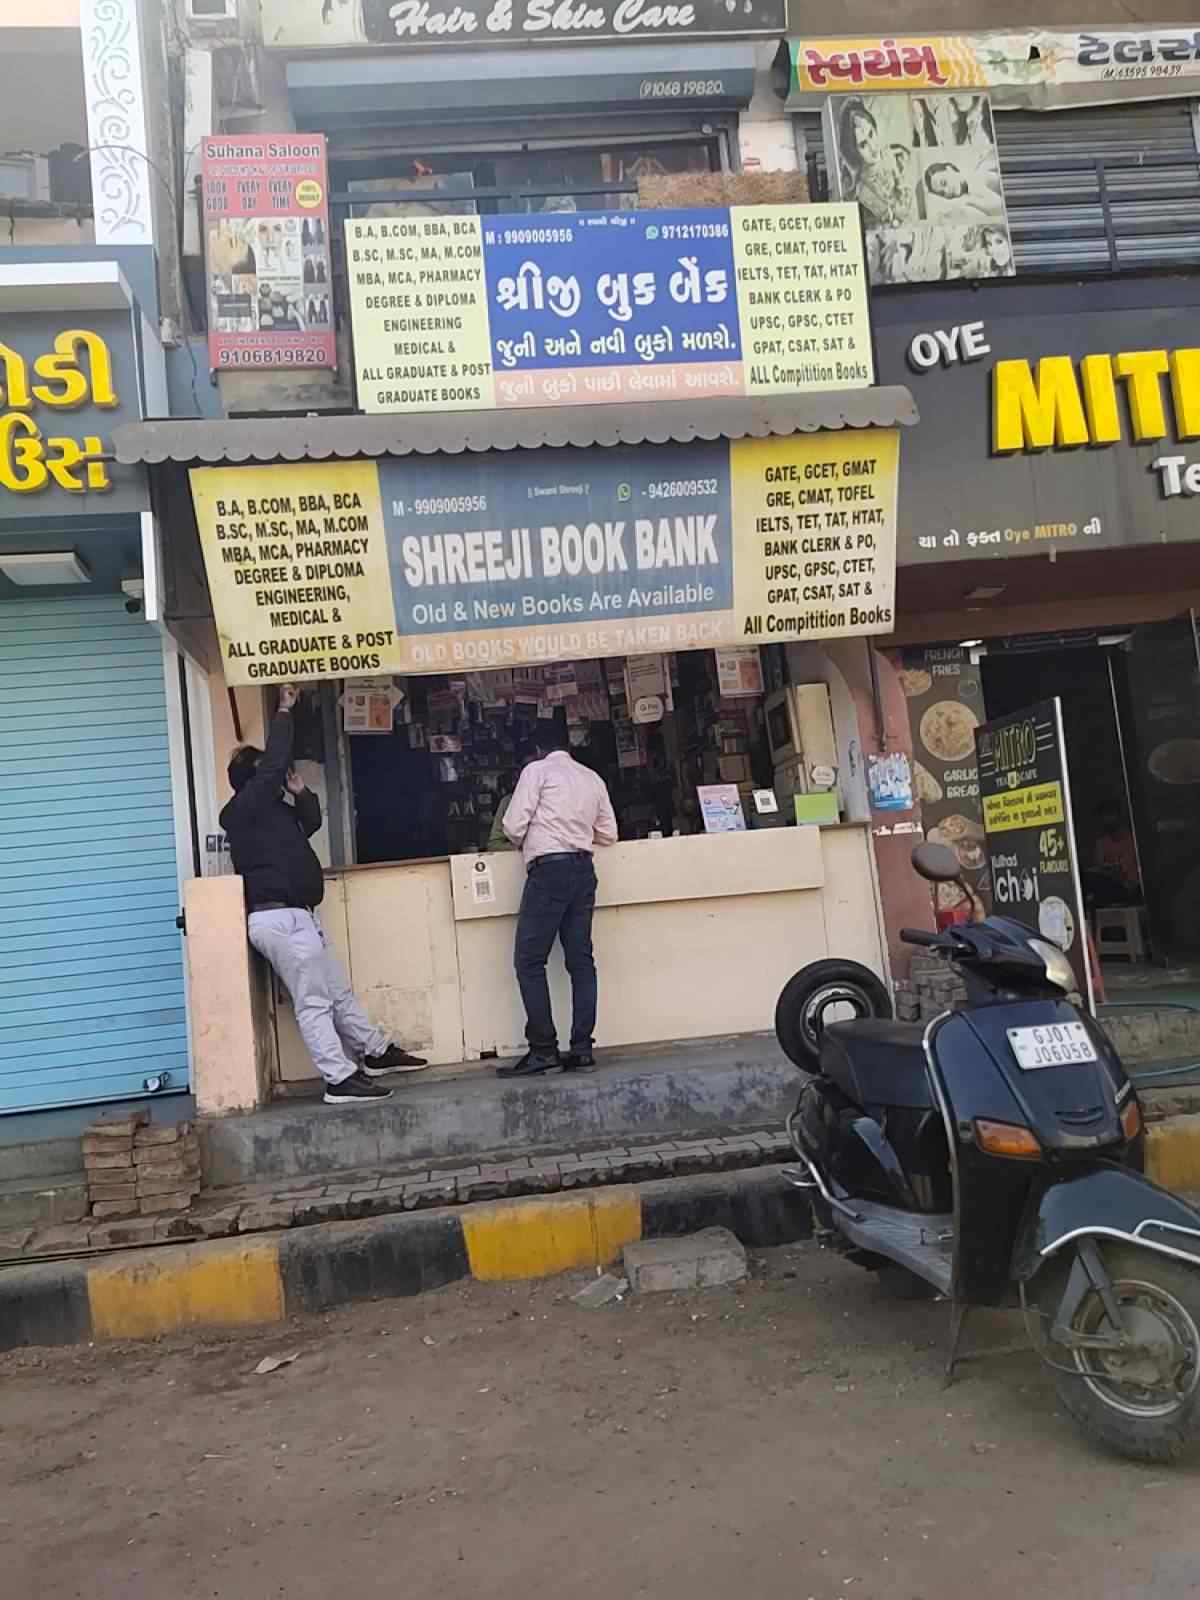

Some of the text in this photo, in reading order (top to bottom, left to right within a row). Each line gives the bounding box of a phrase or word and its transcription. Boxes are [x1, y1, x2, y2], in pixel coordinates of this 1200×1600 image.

[389, 1, 477, 35] Hair
[486, 2, 512, 31] &
[523, 0, 606, 31] Skin
[612, 0, 696, 32] Care
[207, 143, 320, 159] Suhana Saloon
[355, 222, 476, 240] B.A, B.COM, BBA, BCA
[742, 216, 846, 233] GATE, GCET, GMAT
[504, 229, 573, 244] 9909005956
[353, 245, 481, 263] B.SC, M.SC, MA, M.COM
[745, 240, 847, 258] GRE, CMAT, TOFEL
[356, 268, 481, 286] MBA, MCA, PHARMACY
[738, 264, 858, 282] IELTS, TET, TAT, HTAT
[366, 293, 476, 309] DEGREE DIPLOMA
[496, 261, 581, 318] શ્રીજી
[596, 272, 656, 321] બુક
[749, 288, 852, 305] BANK CLERK PO
[384, 317, 462, 332] ENGINEERING
[750, 312, 855, 331] UPSC, GPSC, CTET
[394, 342, 445, 355] MEDICAL
[544, 329, 581, 356] અને
[590, 328, 626, 354] નવી
[634, 325, 673, 361] બુકો
[753, 337, 844, 356] GPAT, CSAT, SAT
[910, 321, 991, 367] OYE
[220, 349, 326, 366] 9106819820
[362, 363, 491, 381] ALL GRADUATE POST
[772, 363, 833, 387] Compitition
[836, 361, 868, 379] Books
[377, 387, 481, 404] GRADUATE BOOKS
[765, 459, 877, 483] GATE, GCET, GMAT
[648, 479, 718, 500] 9426009532
[766, 484, 875, 508] GRE, CMAT, TOFEL
[216, 493, 362, 519] B.A, B.COM, BBA, BCA
[415, 496, 488, 515] 9909005956
[216, 515, 369, 542] B.SC, M.SC, MA, M.COM
[756, 508, 885, 534] IELTS, TET, TAT, HTAT,
[1004, 527, 1031, 544] Oye
[1034, 523, 1077, 539] MITRO
[1082, 517, 1101, 535] ની
[222, 538, 369, 565] MBA, MCA, PHARMACY
[401, 514, 719, 588] SHREEJI BOOK BANK
[764, 534, 876, 556] BANK CLERK PO,
[234, 561, 365, 585] DEGREE DIPLOMA
[765, 558, 875, 581] UPSC, GPSC, CTET,
[255, 585, 350, 606] ENGINEERING,
[412, 581, 714, 625] Old & New Books Are Available
[767, 582, 861, 605] GPAT, CSAT, SAT
[270, 609, 328, 628] MEDICAL
[744, 604, 892, 635] All Compitition Books
[228, 631, 393, 658] ALL GRADUATE POST
[411, 620, 723, 661] OLD BOOKS WOULD BE TAKEN BACK
[248, 653, 380, 678] GRADUATE BOOKS
[932, 664, 961, 676] FRIES
